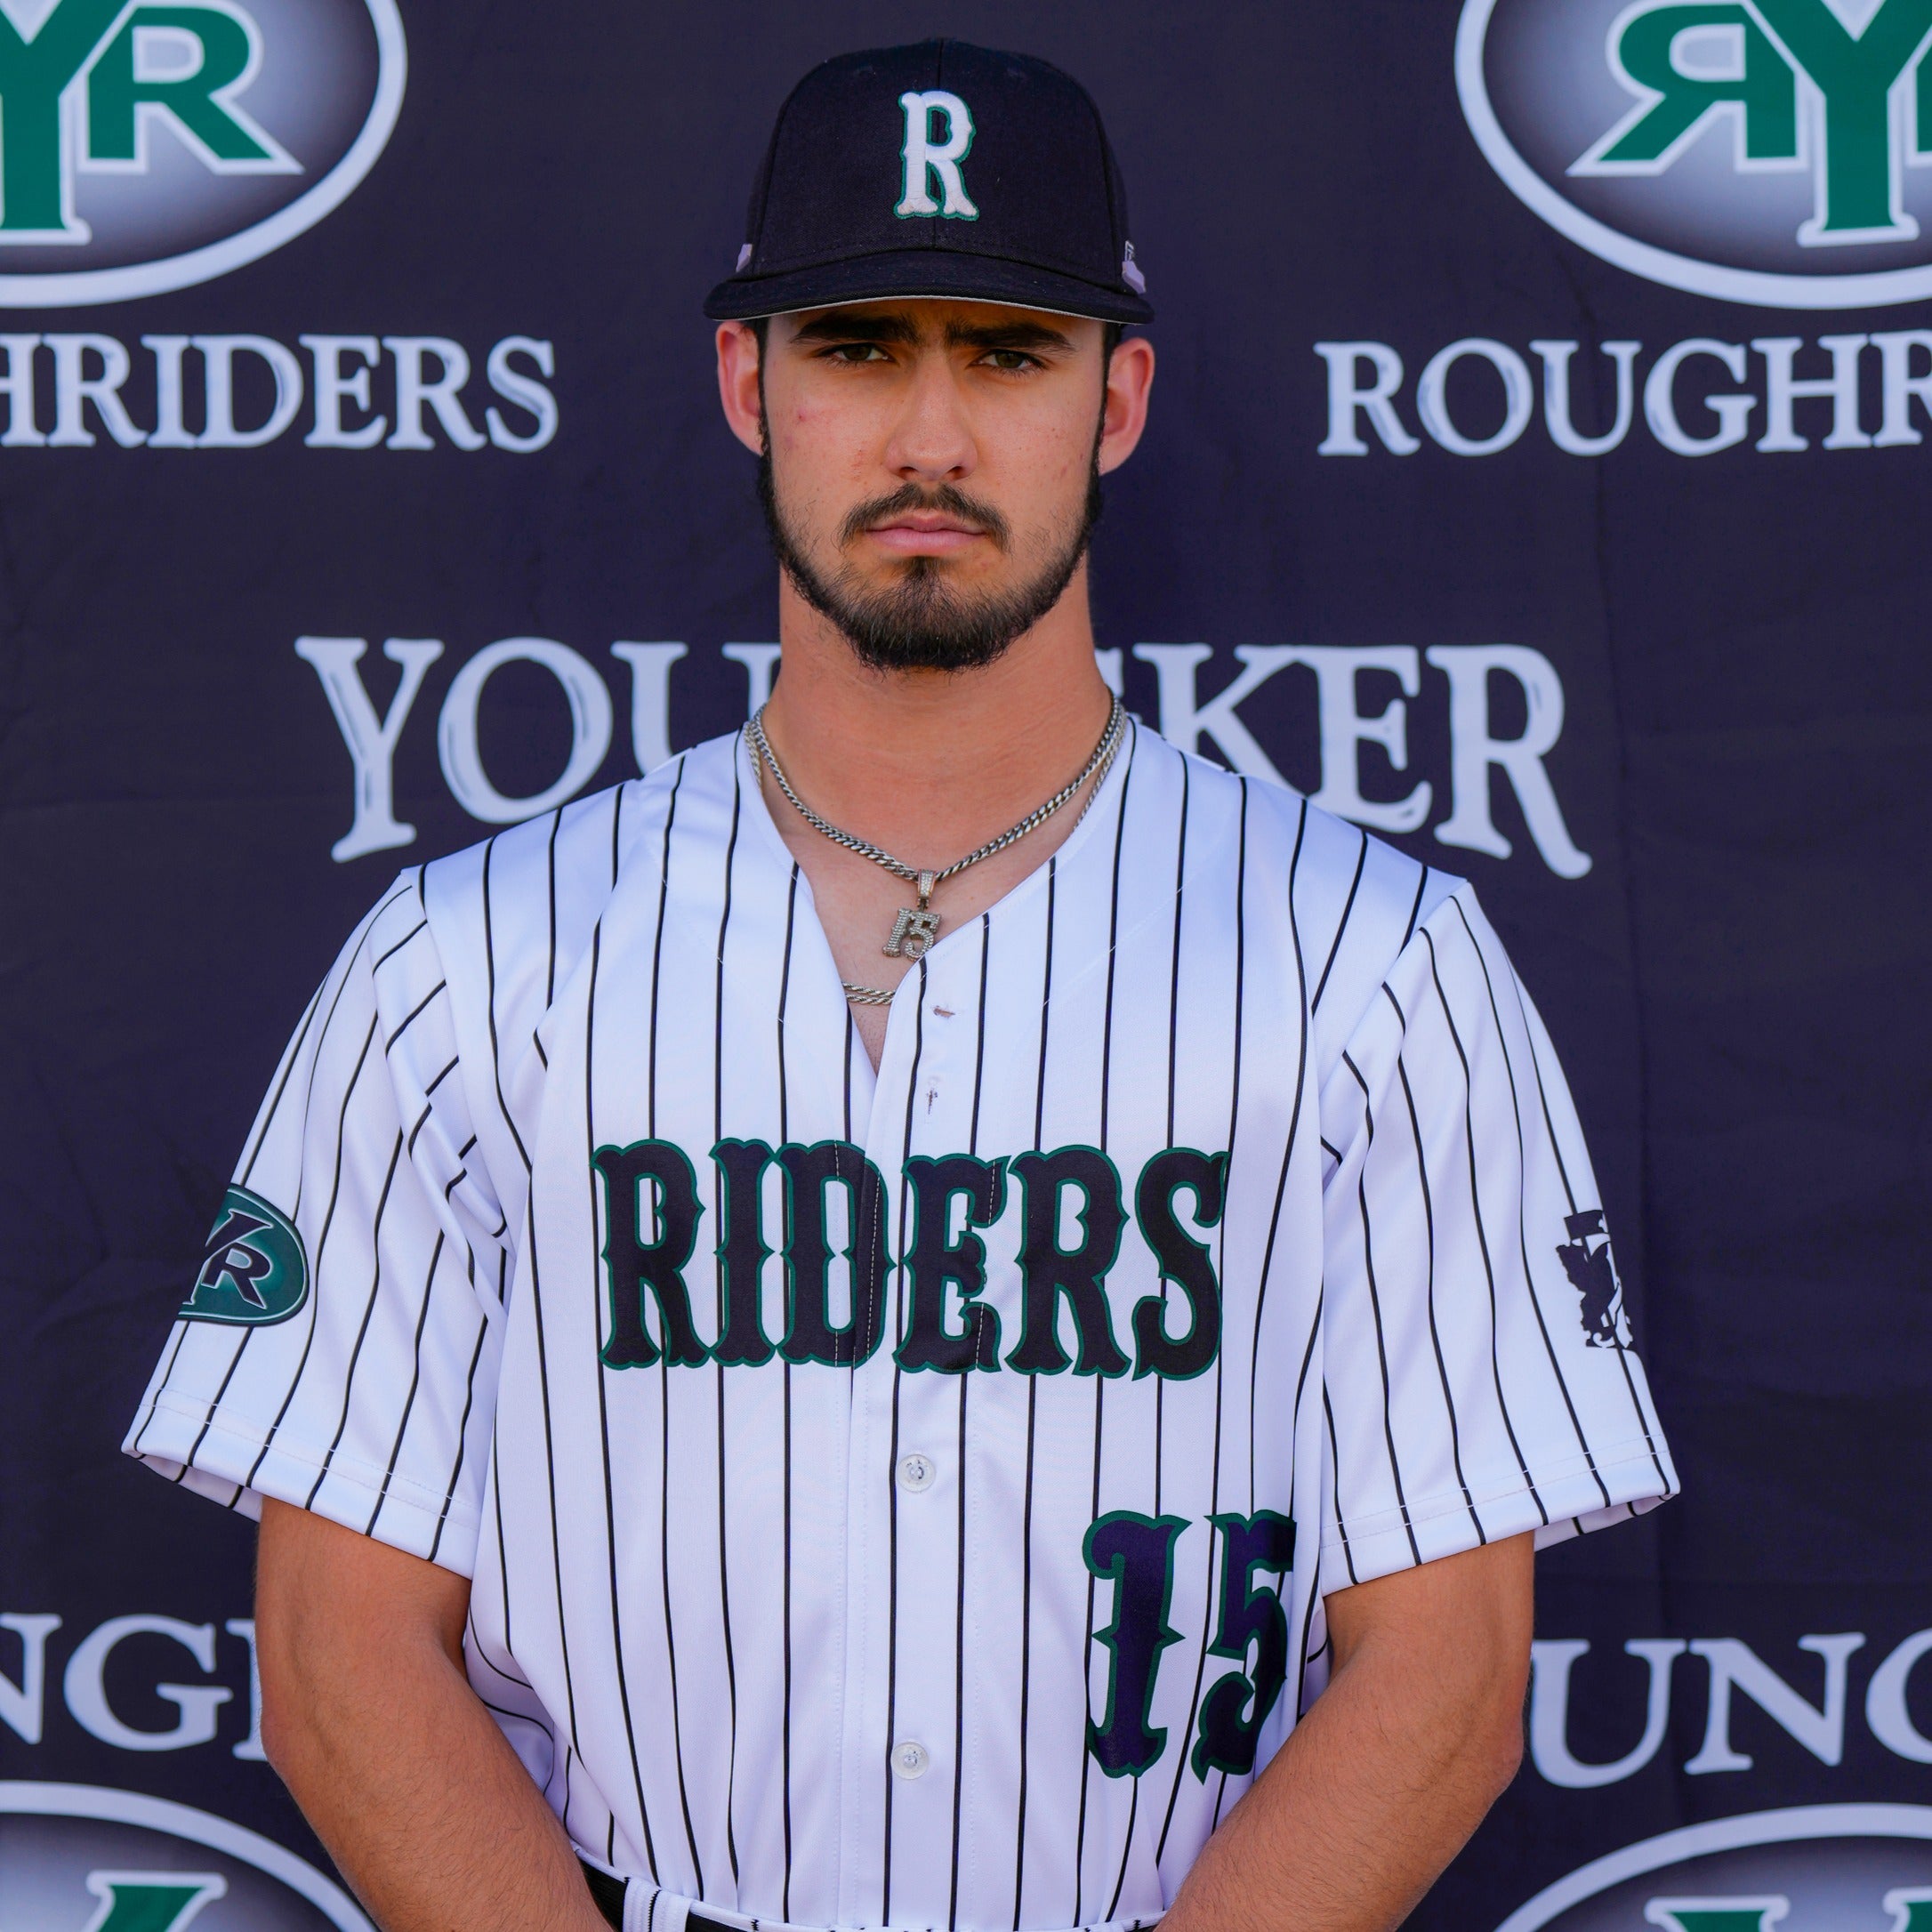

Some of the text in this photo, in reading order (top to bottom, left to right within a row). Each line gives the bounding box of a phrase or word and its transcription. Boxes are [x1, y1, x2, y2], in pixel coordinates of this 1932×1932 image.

[894, 89, 979, 221] R
[1566, 0, 1932, 247] RY
[294, 636, 1592, 879] YOUKER
[882, 907, 941, 962] 15
[590, 1138, 1232, 1381] RIDERS
[1082, 1509, 1297, 1785] 15
